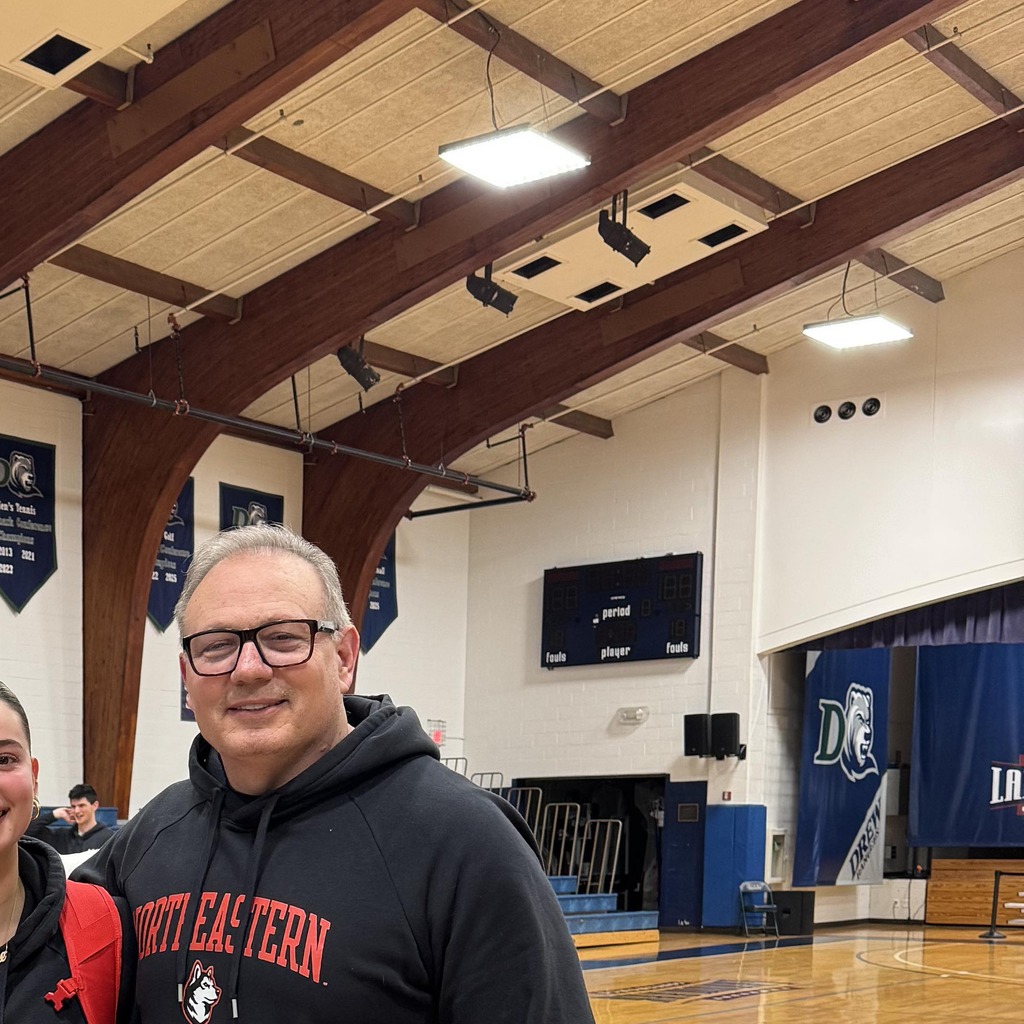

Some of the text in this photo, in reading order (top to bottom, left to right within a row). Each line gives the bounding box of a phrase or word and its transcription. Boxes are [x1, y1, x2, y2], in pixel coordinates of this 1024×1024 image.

[15, 502, 36, 516] Tennis
[603, 604, 631, 620] period
[601, 645, 631, 660] player
[666, 641, 688, 654] fouls
[546, 651, 566, 663] fouls
